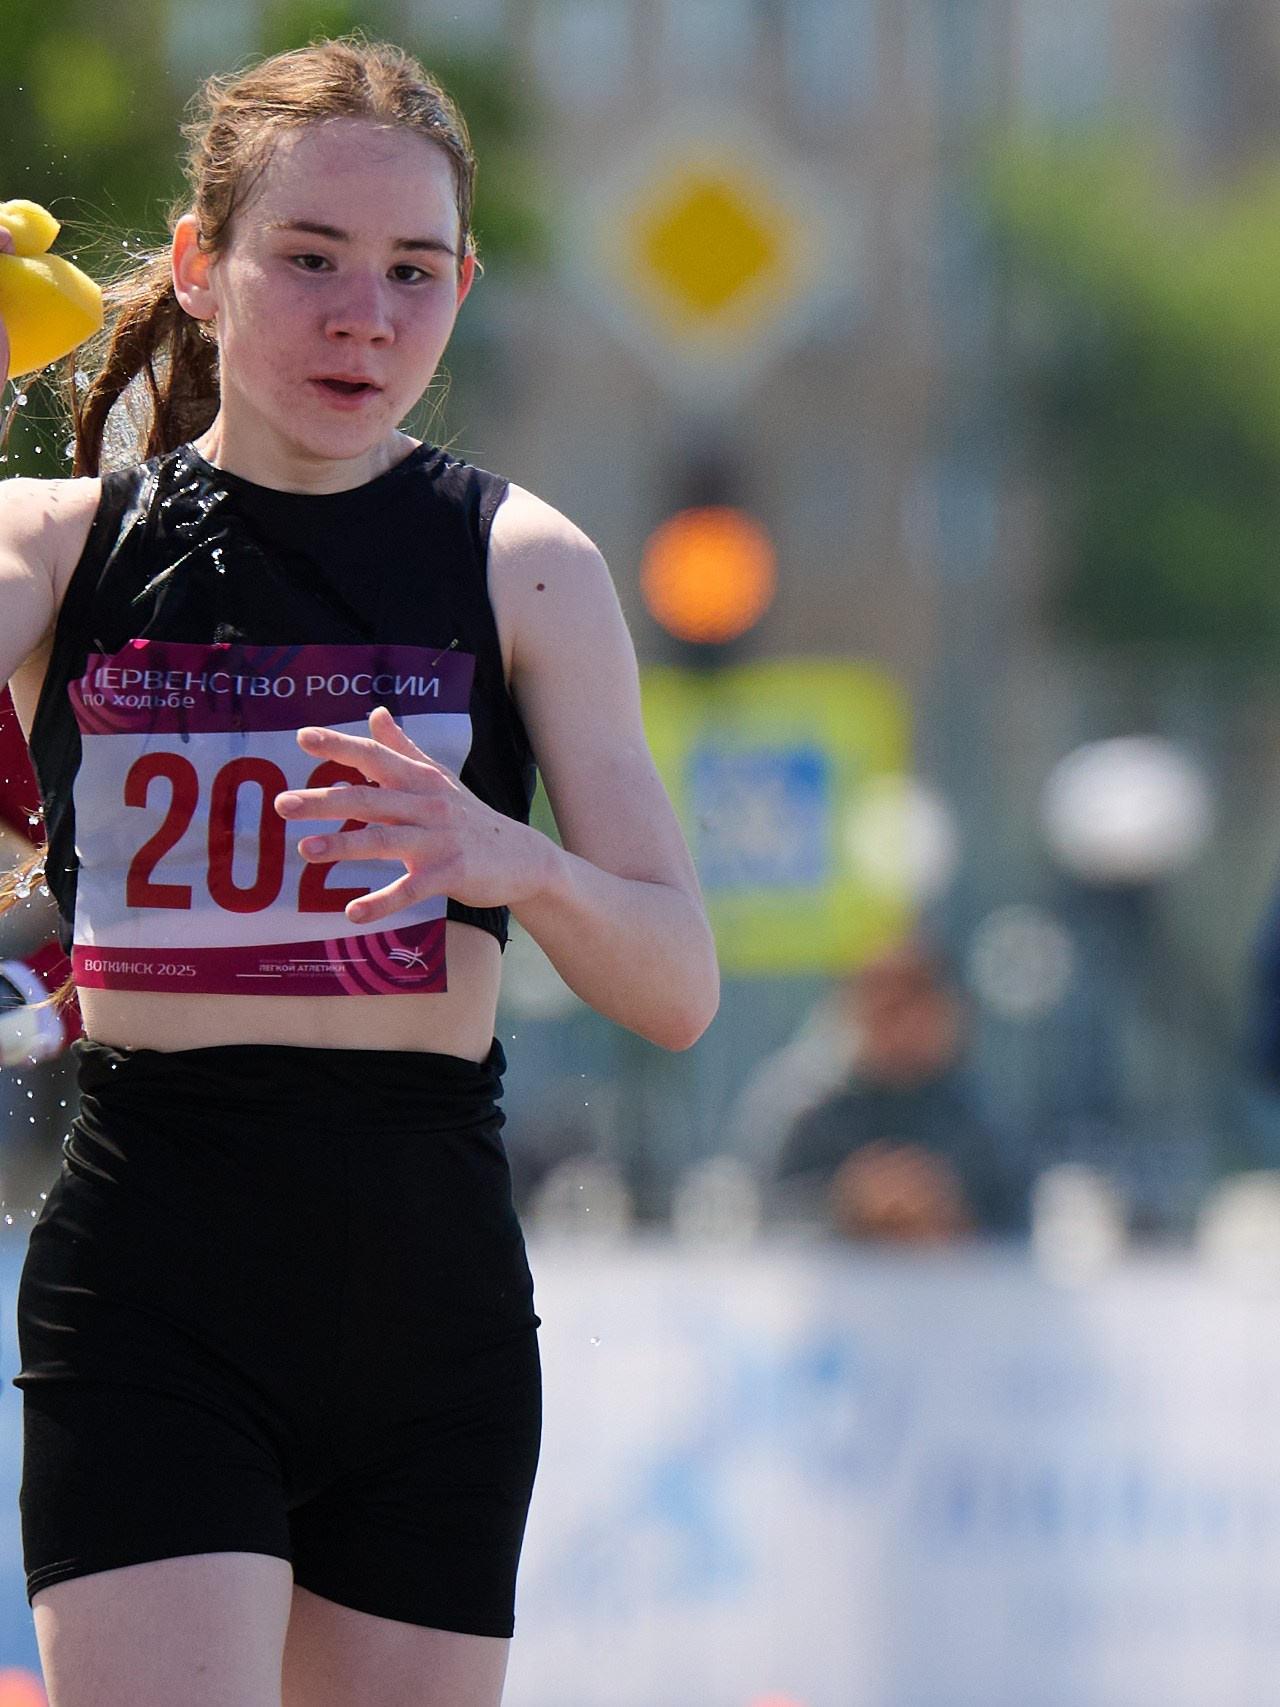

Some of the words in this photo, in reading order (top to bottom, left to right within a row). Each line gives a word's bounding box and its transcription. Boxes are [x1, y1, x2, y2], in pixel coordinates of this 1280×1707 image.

[306, 673, 440, 698] РОССИИ
[83, 694, 105, 707] по
[113, 692, 196, 709] ходьбе
[84, 959, 154, 975] ВОТКИНСК
[157, 963, 197, 977] 2025
